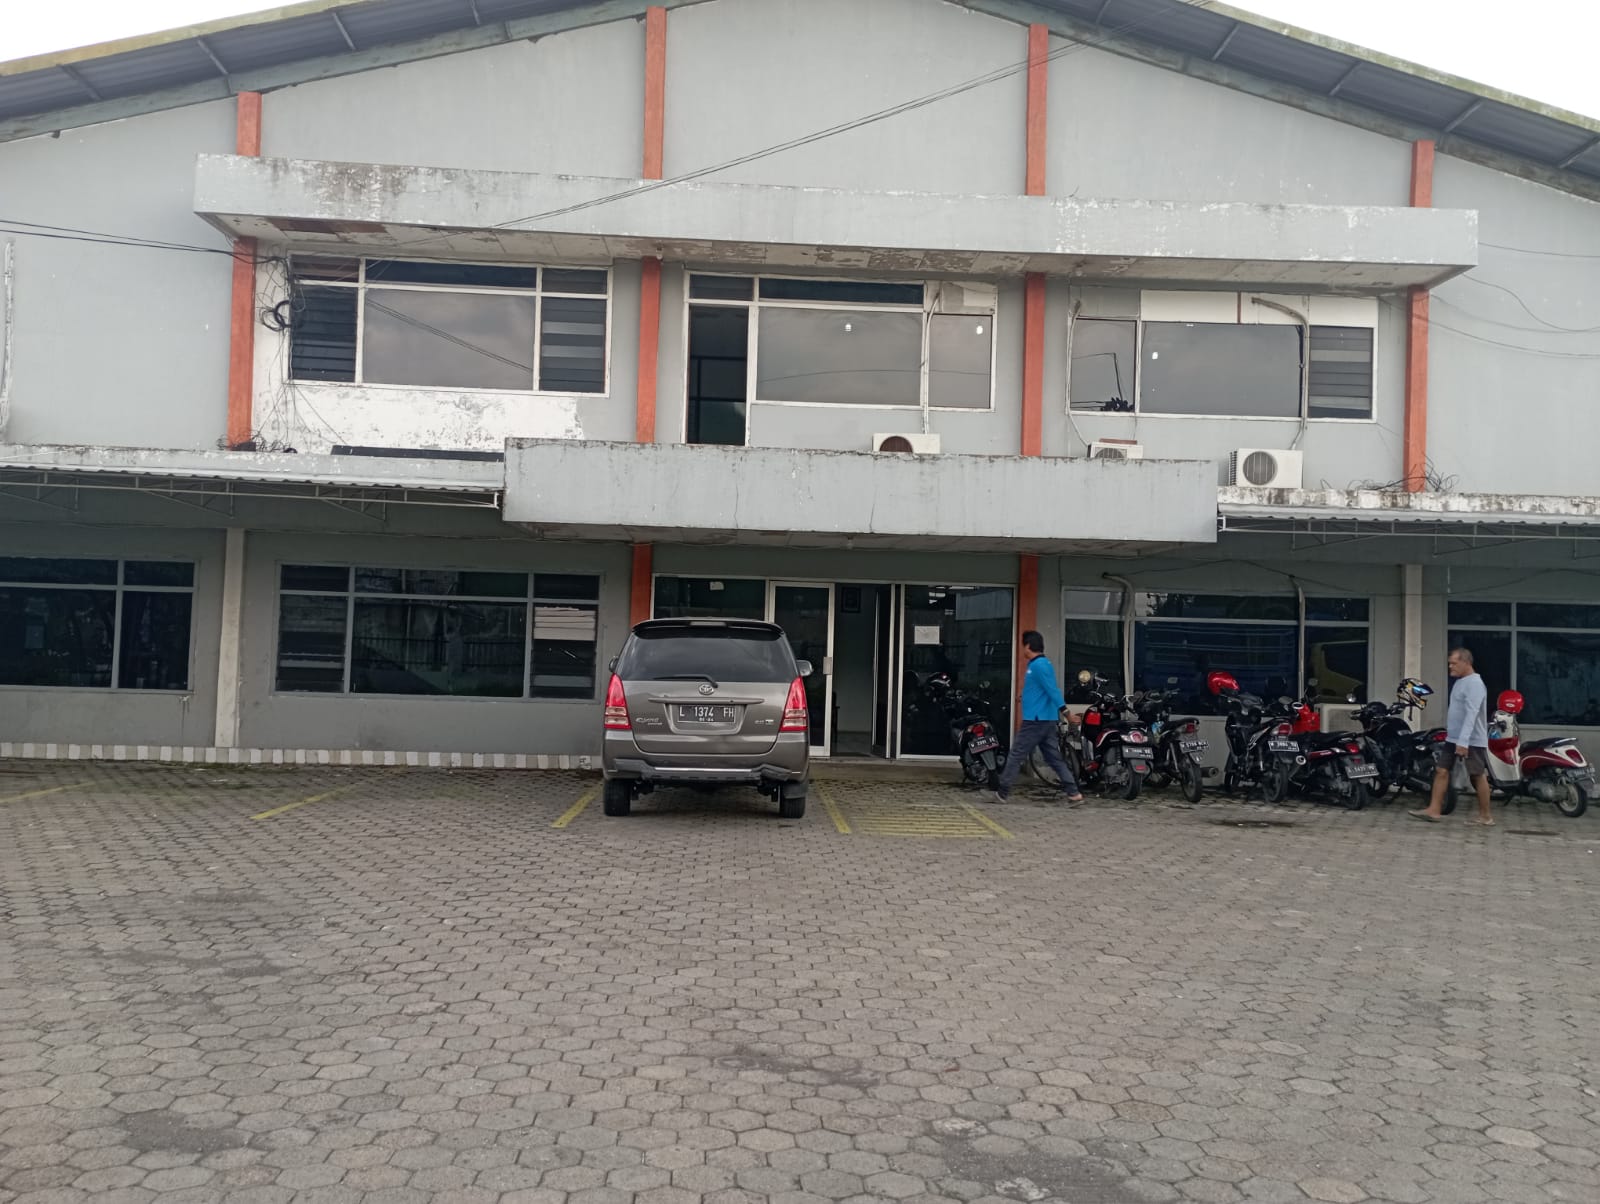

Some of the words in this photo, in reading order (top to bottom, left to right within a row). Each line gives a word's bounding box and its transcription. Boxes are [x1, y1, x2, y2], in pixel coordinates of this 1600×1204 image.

[680, 706, 685, 717] L
[695, 706, 714, 717] 1374
[723, 707, 734, 717] FH
